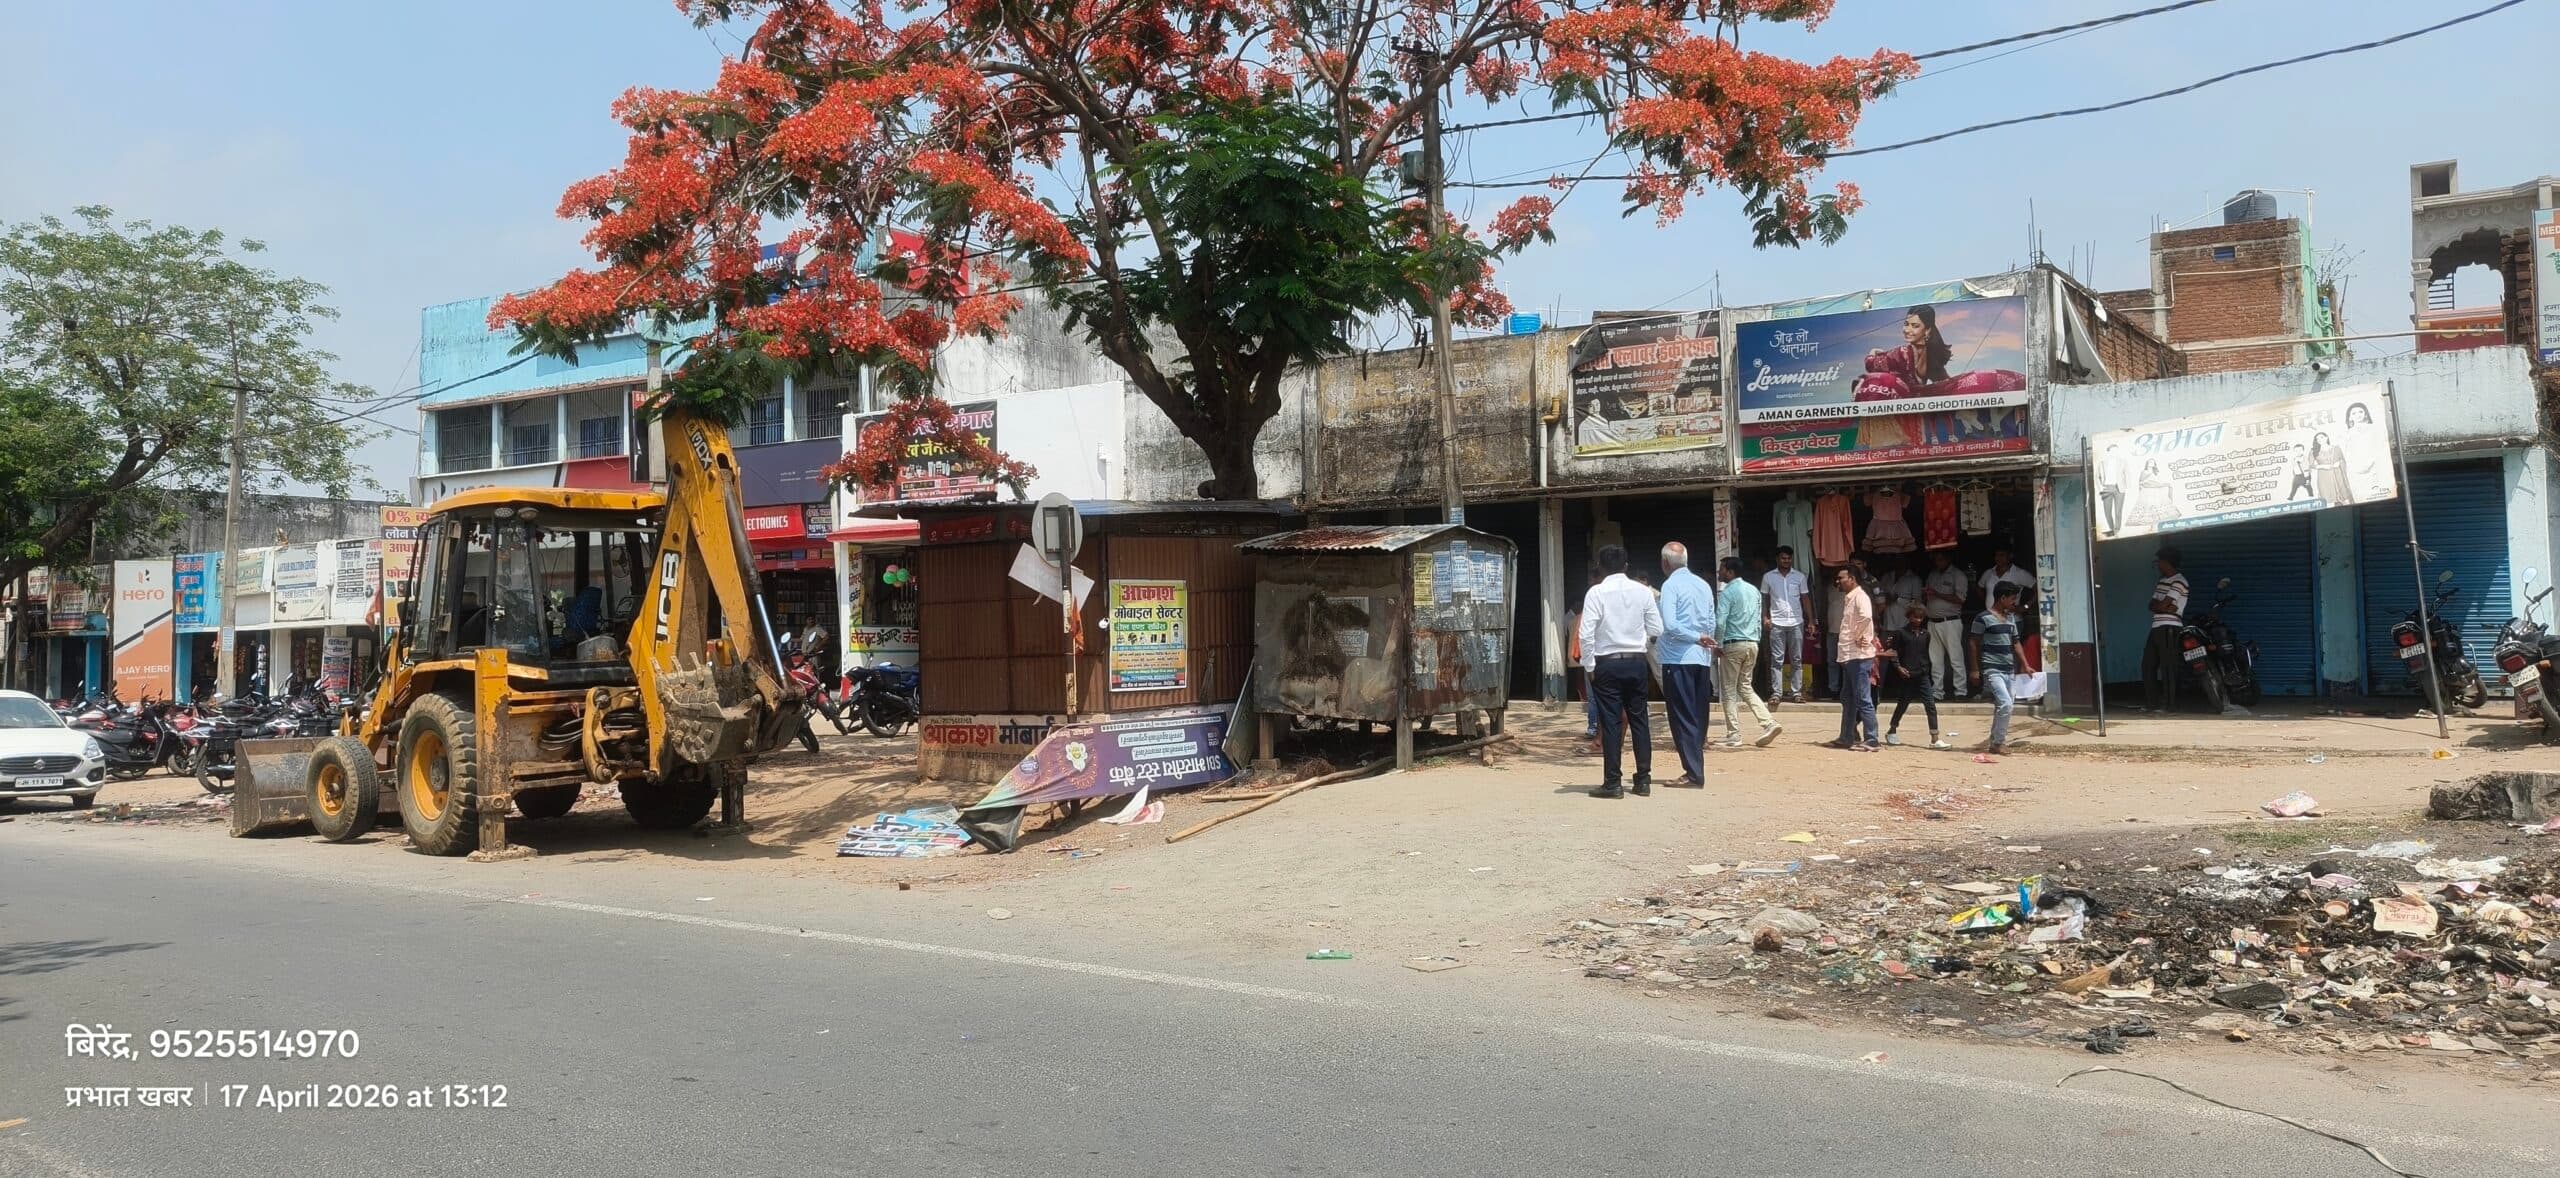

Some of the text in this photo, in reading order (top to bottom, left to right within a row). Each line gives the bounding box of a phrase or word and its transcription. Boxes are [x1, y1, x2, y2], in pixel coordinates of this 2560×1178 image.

[1747, 365, 1839, 392] Laxmipati
[1758, 408, 1793, 421] AMAN
[1795, 405, 1859, 418] GARMENTS
[1896, 401, 1926, 412] ROAD
[1928, 396, 2005, 410] GHODTHAMBA
[1806, 433, 1841, 448] वेयर
[2134, 421, 2227, 456] अमन
[386, 510, 411, 523] 0%
[385, 527, 408, 539] लोन
[389, 543, 418, 553] आधा
[656, 552, 680, 644] JCB
[1121, 584, 1175, 601] आकाश
[1115, 605, 1152, 620] मोबाइल
[117, 664, 170, 675] AJAY HERO
[923, 724, 996, 747] आकाश
[1108, 754, 1221, 788] SBI भारतीय स्टेट बैंक
